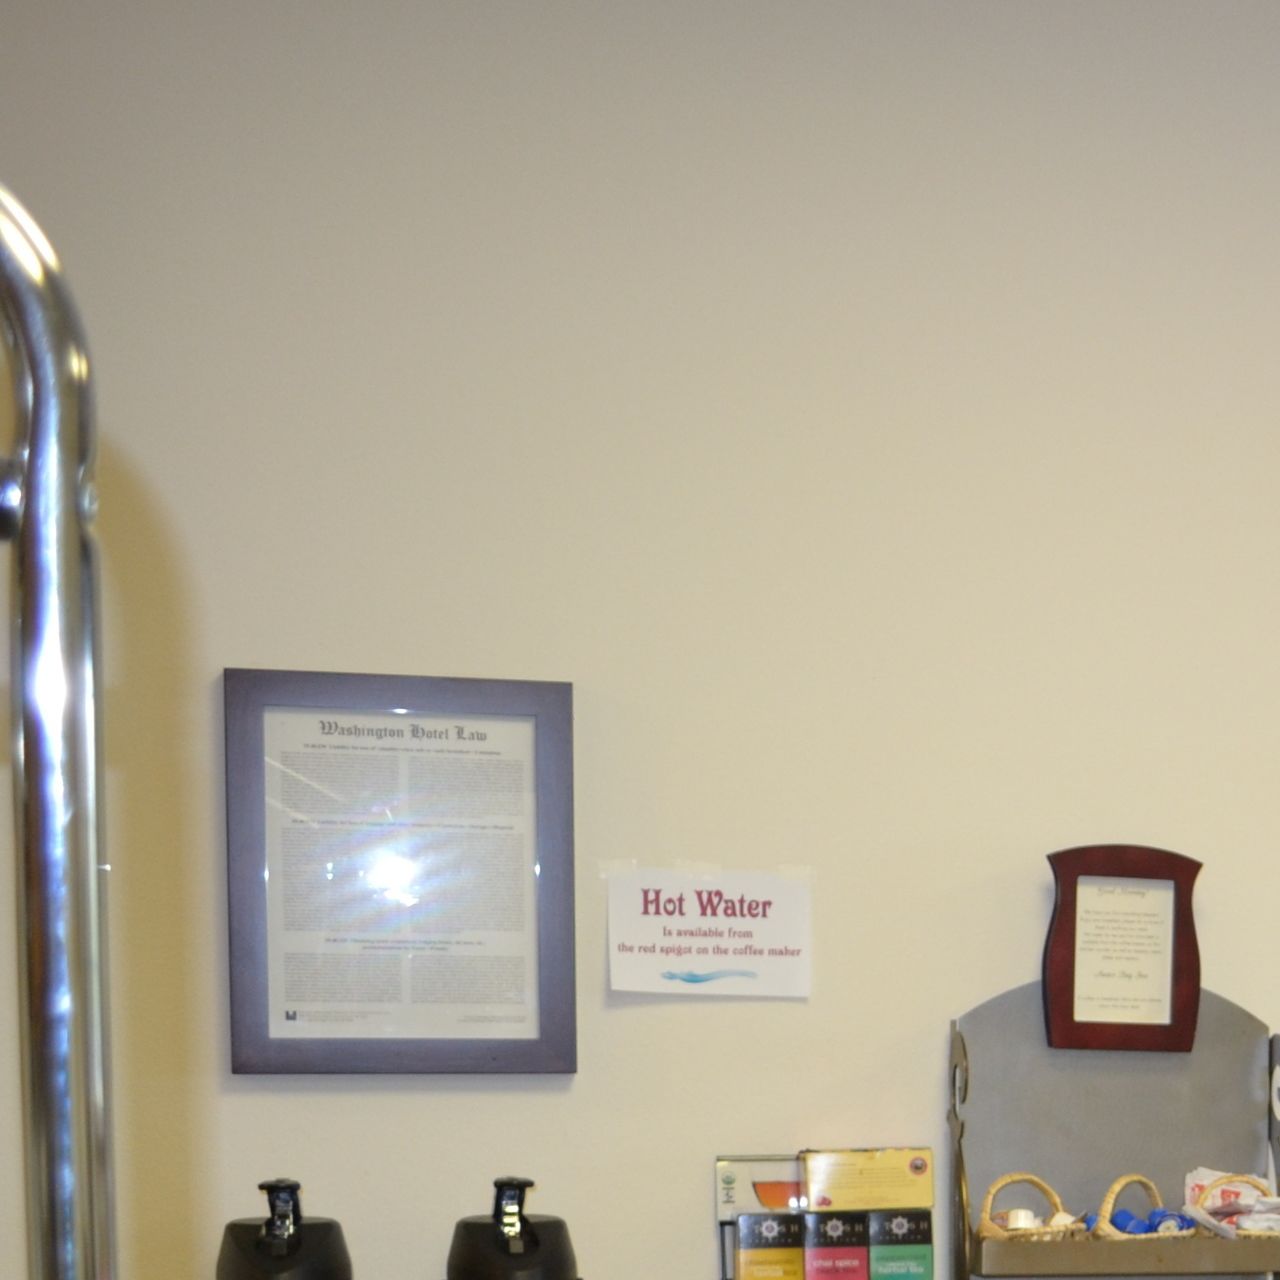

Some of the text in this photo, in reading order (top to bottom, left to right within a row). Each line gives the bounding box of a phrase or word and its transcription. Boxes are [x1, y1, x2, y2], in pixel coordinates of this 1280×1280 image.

[320, 720, 487, 741] Washington Hotel Law
[641, 888, 772, 918] Hot Water
[663, 926, 753, 938] Is available from
[618, 942, 801, 957] the red spigot on the coffee maker
